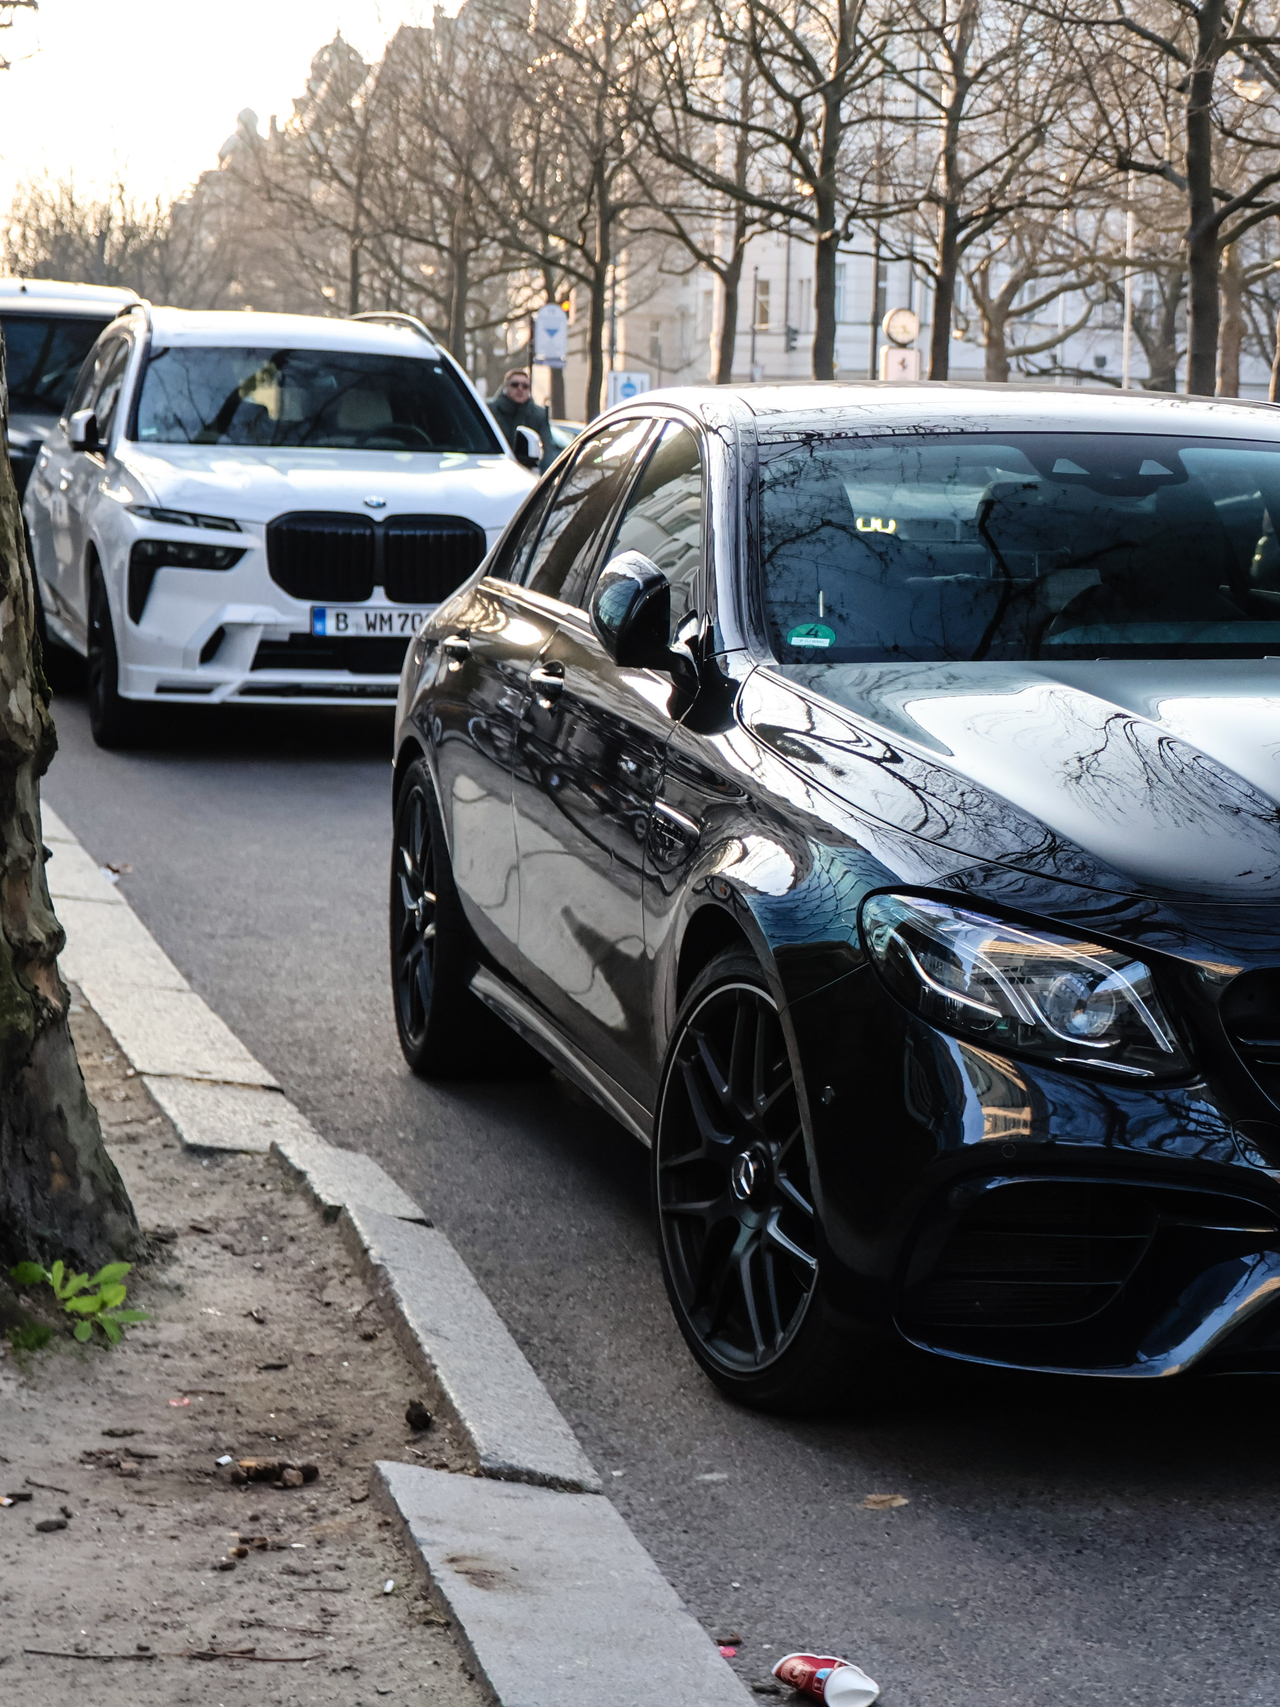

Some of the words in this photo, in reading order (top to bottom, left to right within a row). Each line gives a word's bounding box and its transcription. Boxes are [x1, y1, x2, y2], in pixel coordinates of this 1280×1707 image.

[335, 613, 348, 632] B
[365, 612, 393, 632] WM
[398, 612, 431, 632] 70
[805, 624, 820, 638] 4
